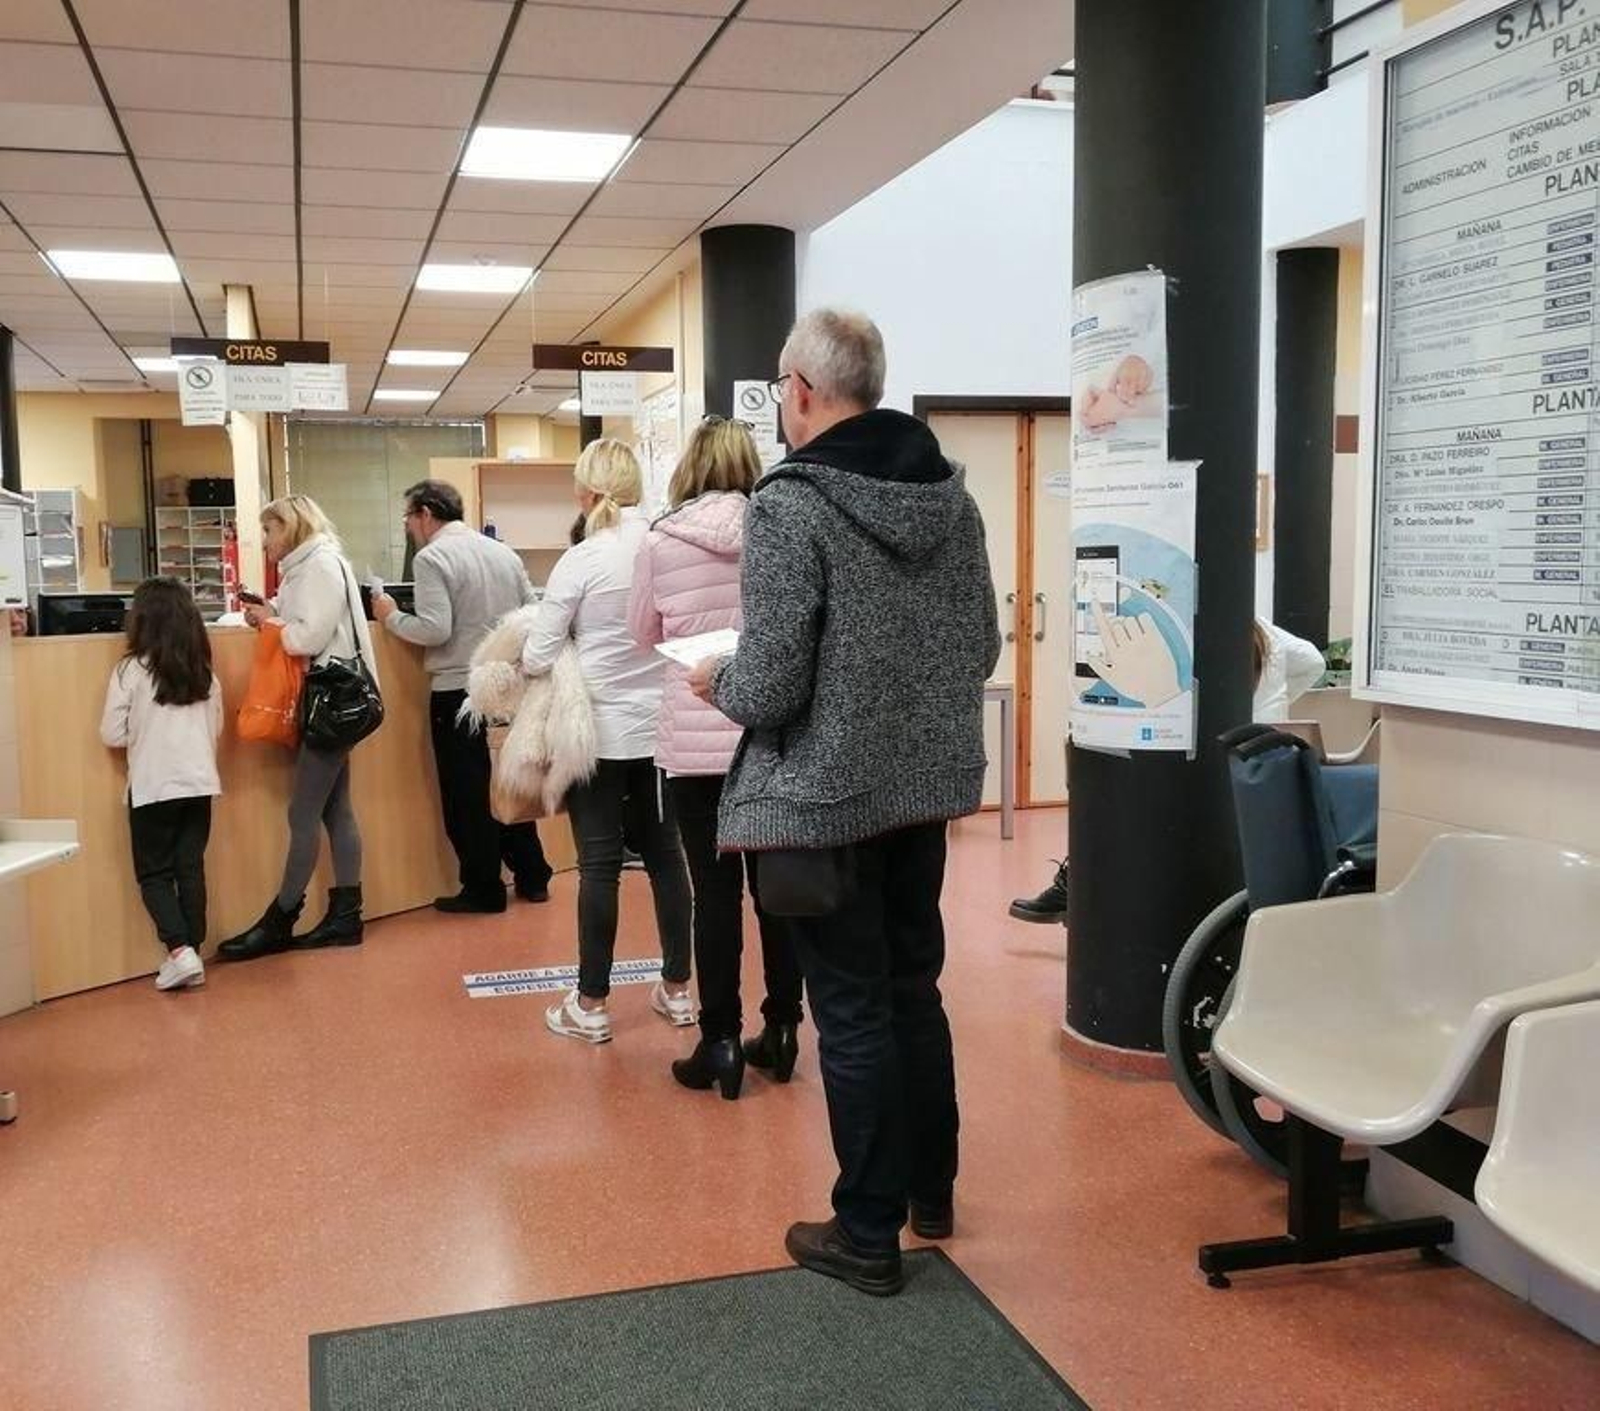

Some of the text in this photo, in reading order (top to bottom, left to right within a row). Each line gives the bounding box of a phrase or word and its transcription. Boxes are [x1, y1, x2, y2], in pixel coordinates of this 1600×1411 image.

[1509, 107, 1590, 143] INFORMACION
[1507, 141, 1539, 161] CITAS
[1507, 155, 1551, 178] CAMBIO
[1556, 148, 1573, 163] DE
[1402, 160, 1487, 194] ADMINISTRACION
[226, 344, 278, 361] CITAS
[581, 351, 628, 366] CITAS
[1457, 426, 1502, 441] MAÑANA
[1447, 446, 1490, 459] FERREIRO
